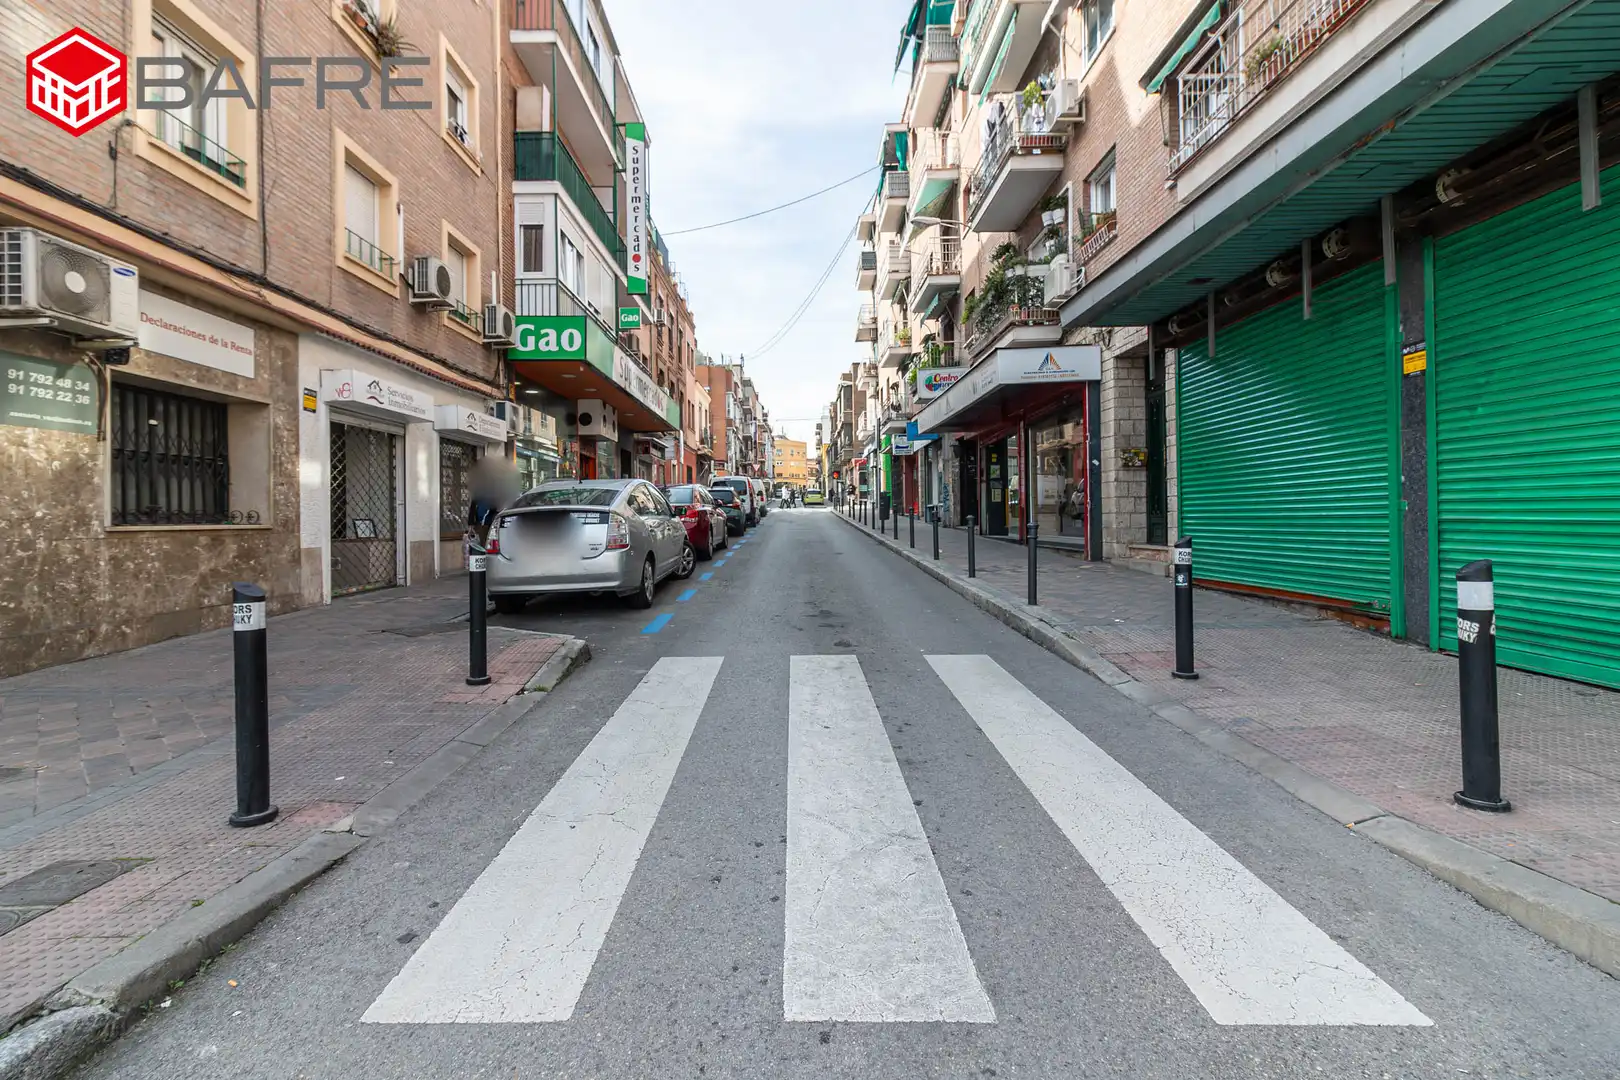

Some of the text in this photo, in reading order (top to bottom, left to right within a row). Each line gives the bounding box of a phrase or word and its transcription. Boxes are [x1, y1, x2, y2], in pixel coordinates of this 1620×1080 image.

[621, 313, 639, 322] Gao
[140, 311, 253, 356] Declaraciones de la Renta
[515, 323, 582, 352] Gao
[7, 368, 90, 391] 91 792 48 34
[933, 373, 959, 383] Centro
[7, 383, 91, 404] 91 792 22 36
[387, 386, 414, 402] Servicios
